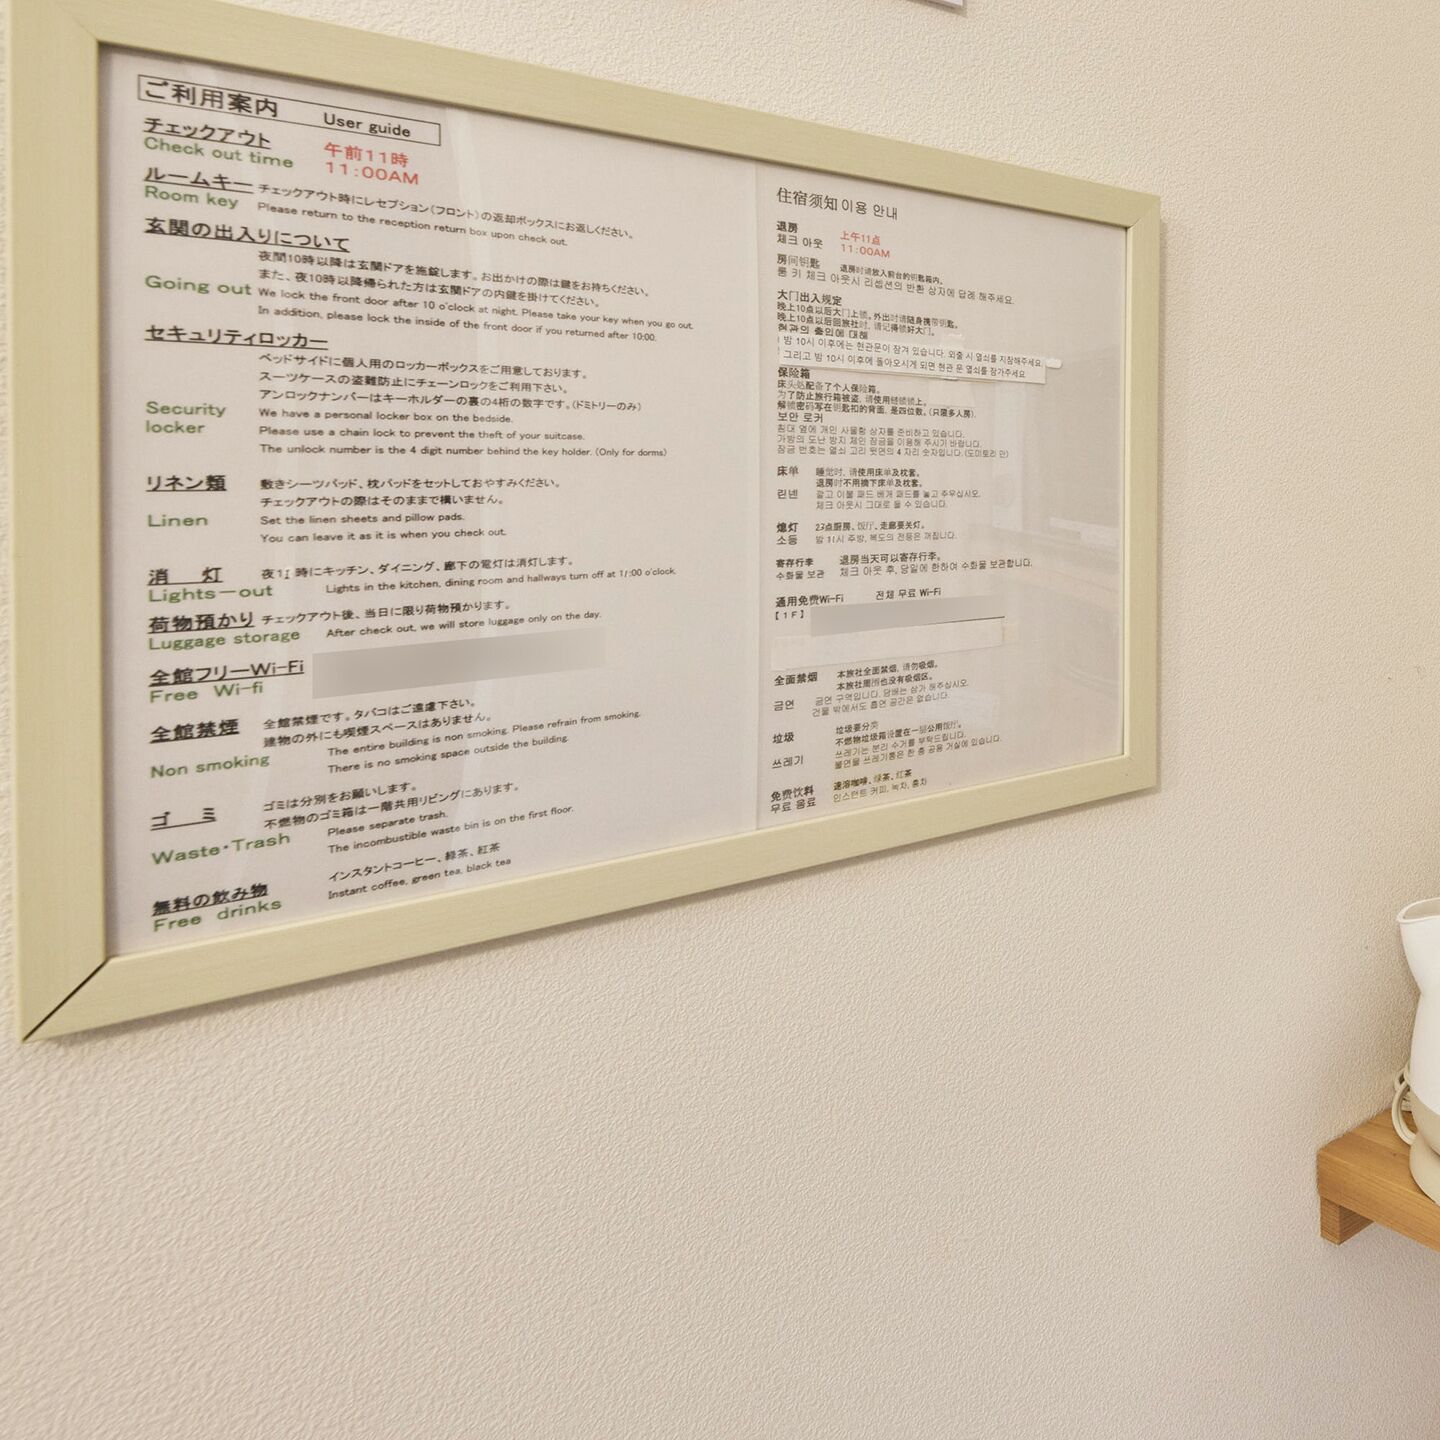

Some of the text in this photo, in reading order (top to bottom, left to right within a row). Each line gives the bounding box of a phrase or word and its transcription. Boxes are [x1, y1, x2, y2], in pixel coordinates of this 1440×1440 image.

[145, 80, 278, 118] ご利用案内
[144, 117, 270, 146] チェックアウト
[324, 112, 411, 138] User guide
[143, 136, 294, 168] Check out time
[323, 141, 409, 168] 午前11時
[145, 167, 253, 188] ルームキー
[325, 161, 419, 186] 11:00AM
[144, 185, 239, 210] Room key
[776, 187, 838, 211] 住宿须知
[841, 199, 897, 221] 이용 안내
[145, 216, 349, 251] 玄関の出入りについて
[257, 202, 568, 246] Please return to the reception return box upon check out.
[776, 233, 823, 250] 체크 아웃
[840, 230, 881, 246] 上午11点
[841, 243, 890, 258] 11:00AM
[144, 275, 252, 296] Going out
[145, 324, 328, 347] セキュリティロッカー
[145, 401, 227, 418] Security
[258, 408, 278, 418] We
[281, 409, 310, 418] have
[324, 411, 373, 420] personal
[376, 411, 411, 421] locker
[413, 412, 432, 421] box
[452, 413, 470, 422] the
[472, 414, 511, 423] bedside.
[145, 420, 206, 434] locker
[147, 474, 226, 489] リネン類
[147, 514, 209, 528] Linen
[260, 512, 465, 525] Set the linen sheets and pillow pads.
[148, 611, 253, 631] 荷物預かり
[148, 631, 301, 651] Luggage storage
[149, 681, 263, 703] Free Wi-fi
[150, 718, 239, 741] 全館禁煙
[150, 755, 270, 779] Non smoking
[327, 810, 448, 837] Please separate trash.
[152, 883, 268, 914] 無料の飲み物
[153, 900, 282, 932] Free drinks
